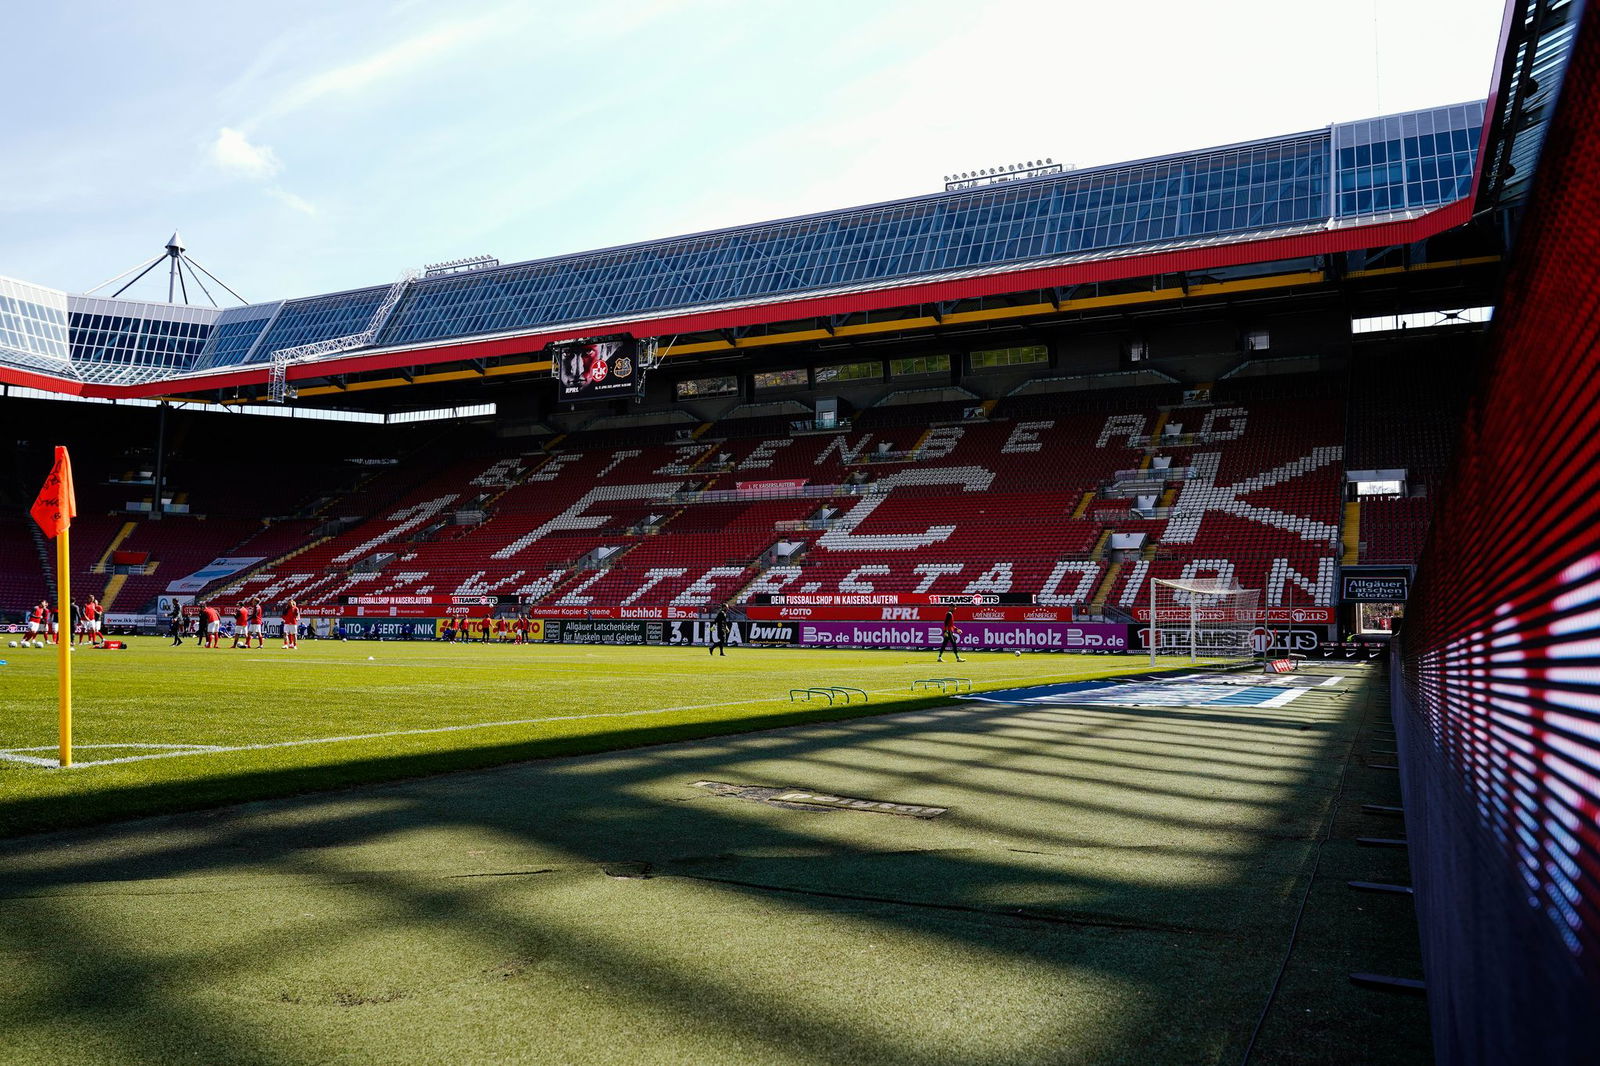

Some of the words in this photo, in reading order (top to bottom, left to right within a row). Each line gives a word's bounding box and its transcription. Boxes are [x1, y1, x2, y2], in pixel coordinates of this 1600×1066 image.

[1349, 579, 1403, 588] Allgäuer
[1348, 586, 1403, 594] Latschen
[348, 596, 358, 605] DEIN
[358, 596, 389, 605] FUSSBALLSHOP
[395, 596, 433, 605] KAISERSLAUTERN
[770, 595, 786, 605] DEIN
[786, 595, 833, 605] FUSSBALLSHOP
[834, 595, 841, 605] IN
[841, 595, 898, 605] KAISERSLAUTERN
[620, 607, 662, 618] buchholz
[788, 607, 812, 616] LOTTO
[881, 607, 920, 620] RPR1.
[566, 622, 592, 632] Allgäuer
[593, 622, 640, 632] Latschenkiefer
[749, 622, 792, 640] bwin
[563, 633, 573, 641] für
[574, 633, 600, 641] Muskeln
[601, 633, 615, 641] und
[615, 633, 642, 642] Gelenke
[853, 627, 924, 644] buchholz
[928, 627, 980, 644] BD.de
[983, 628, 1062, 646] buchholz
